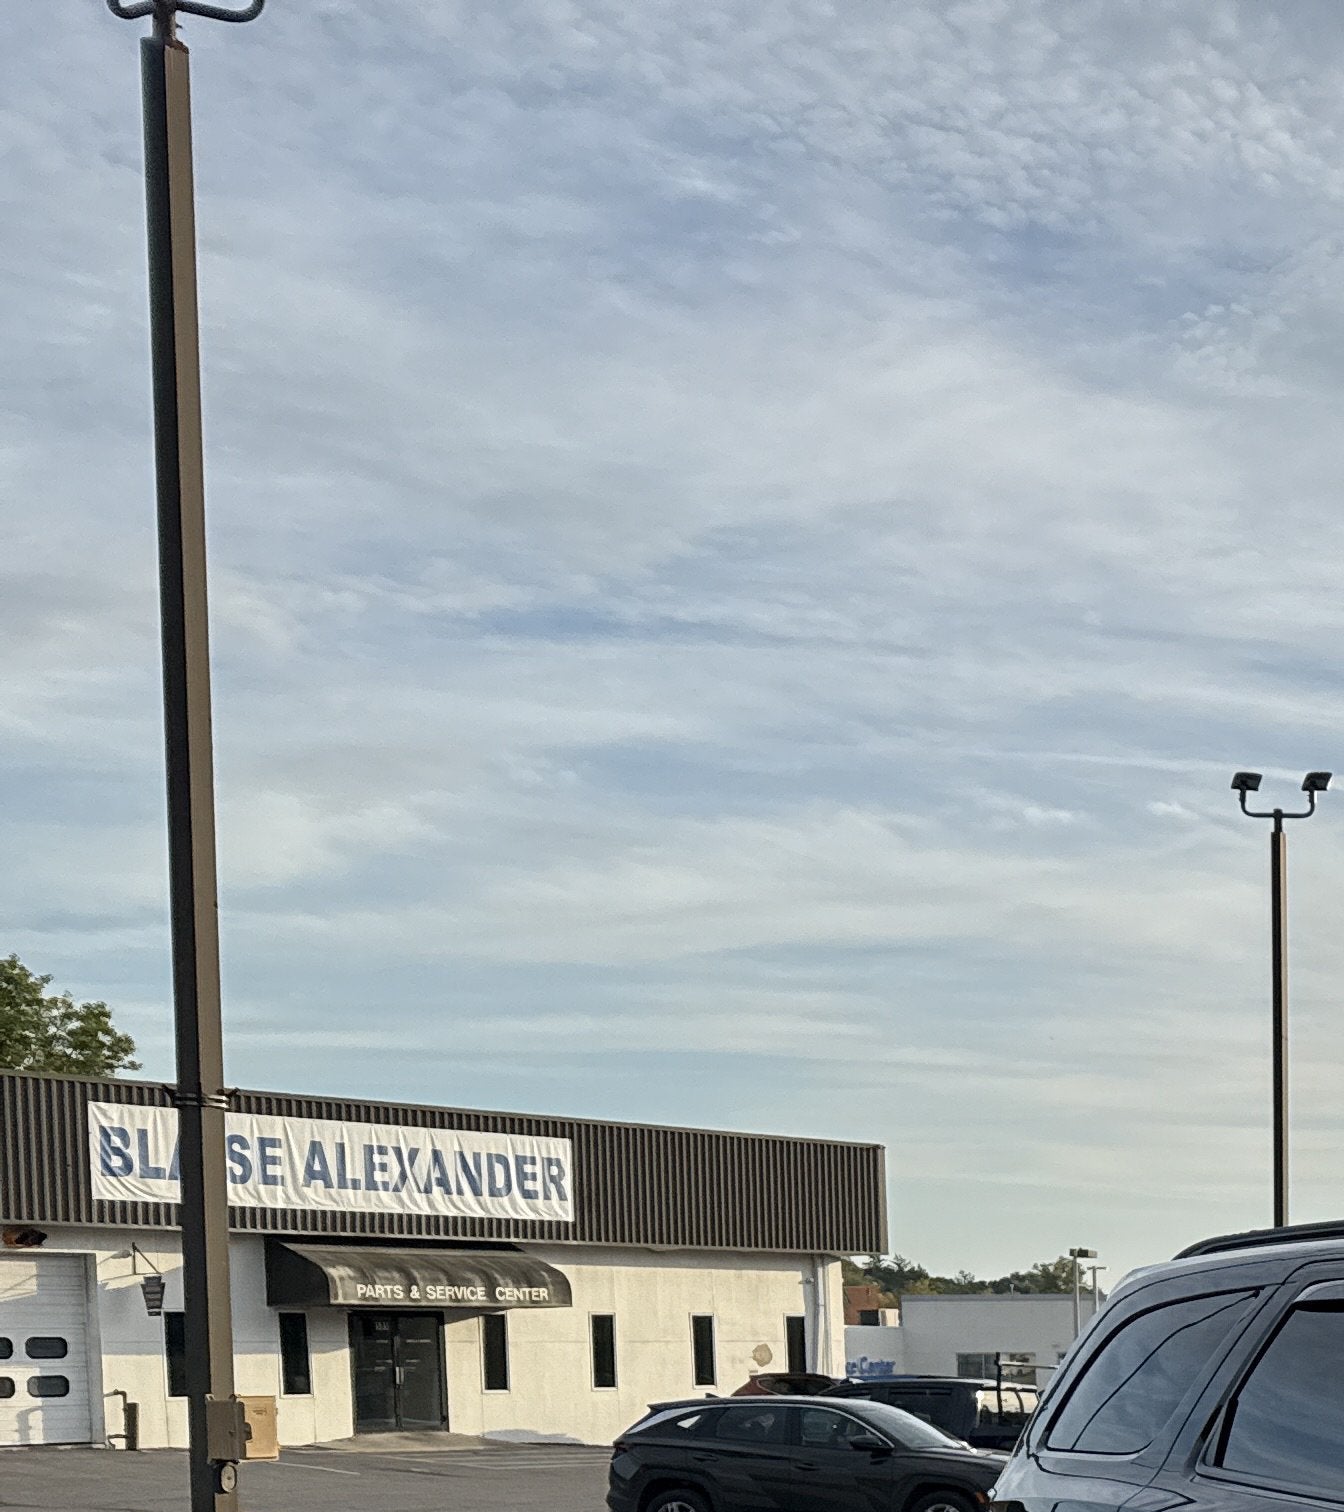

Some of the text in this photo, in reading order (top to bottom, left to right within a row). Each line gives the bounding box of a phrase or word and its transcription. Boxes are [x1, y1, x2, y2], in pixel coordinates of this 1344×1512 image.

[98, 1124, 569, 1202] BLSE ALEXANDER
[356, 1283, 549, 1302] PARTS & SERVICE CENTER
